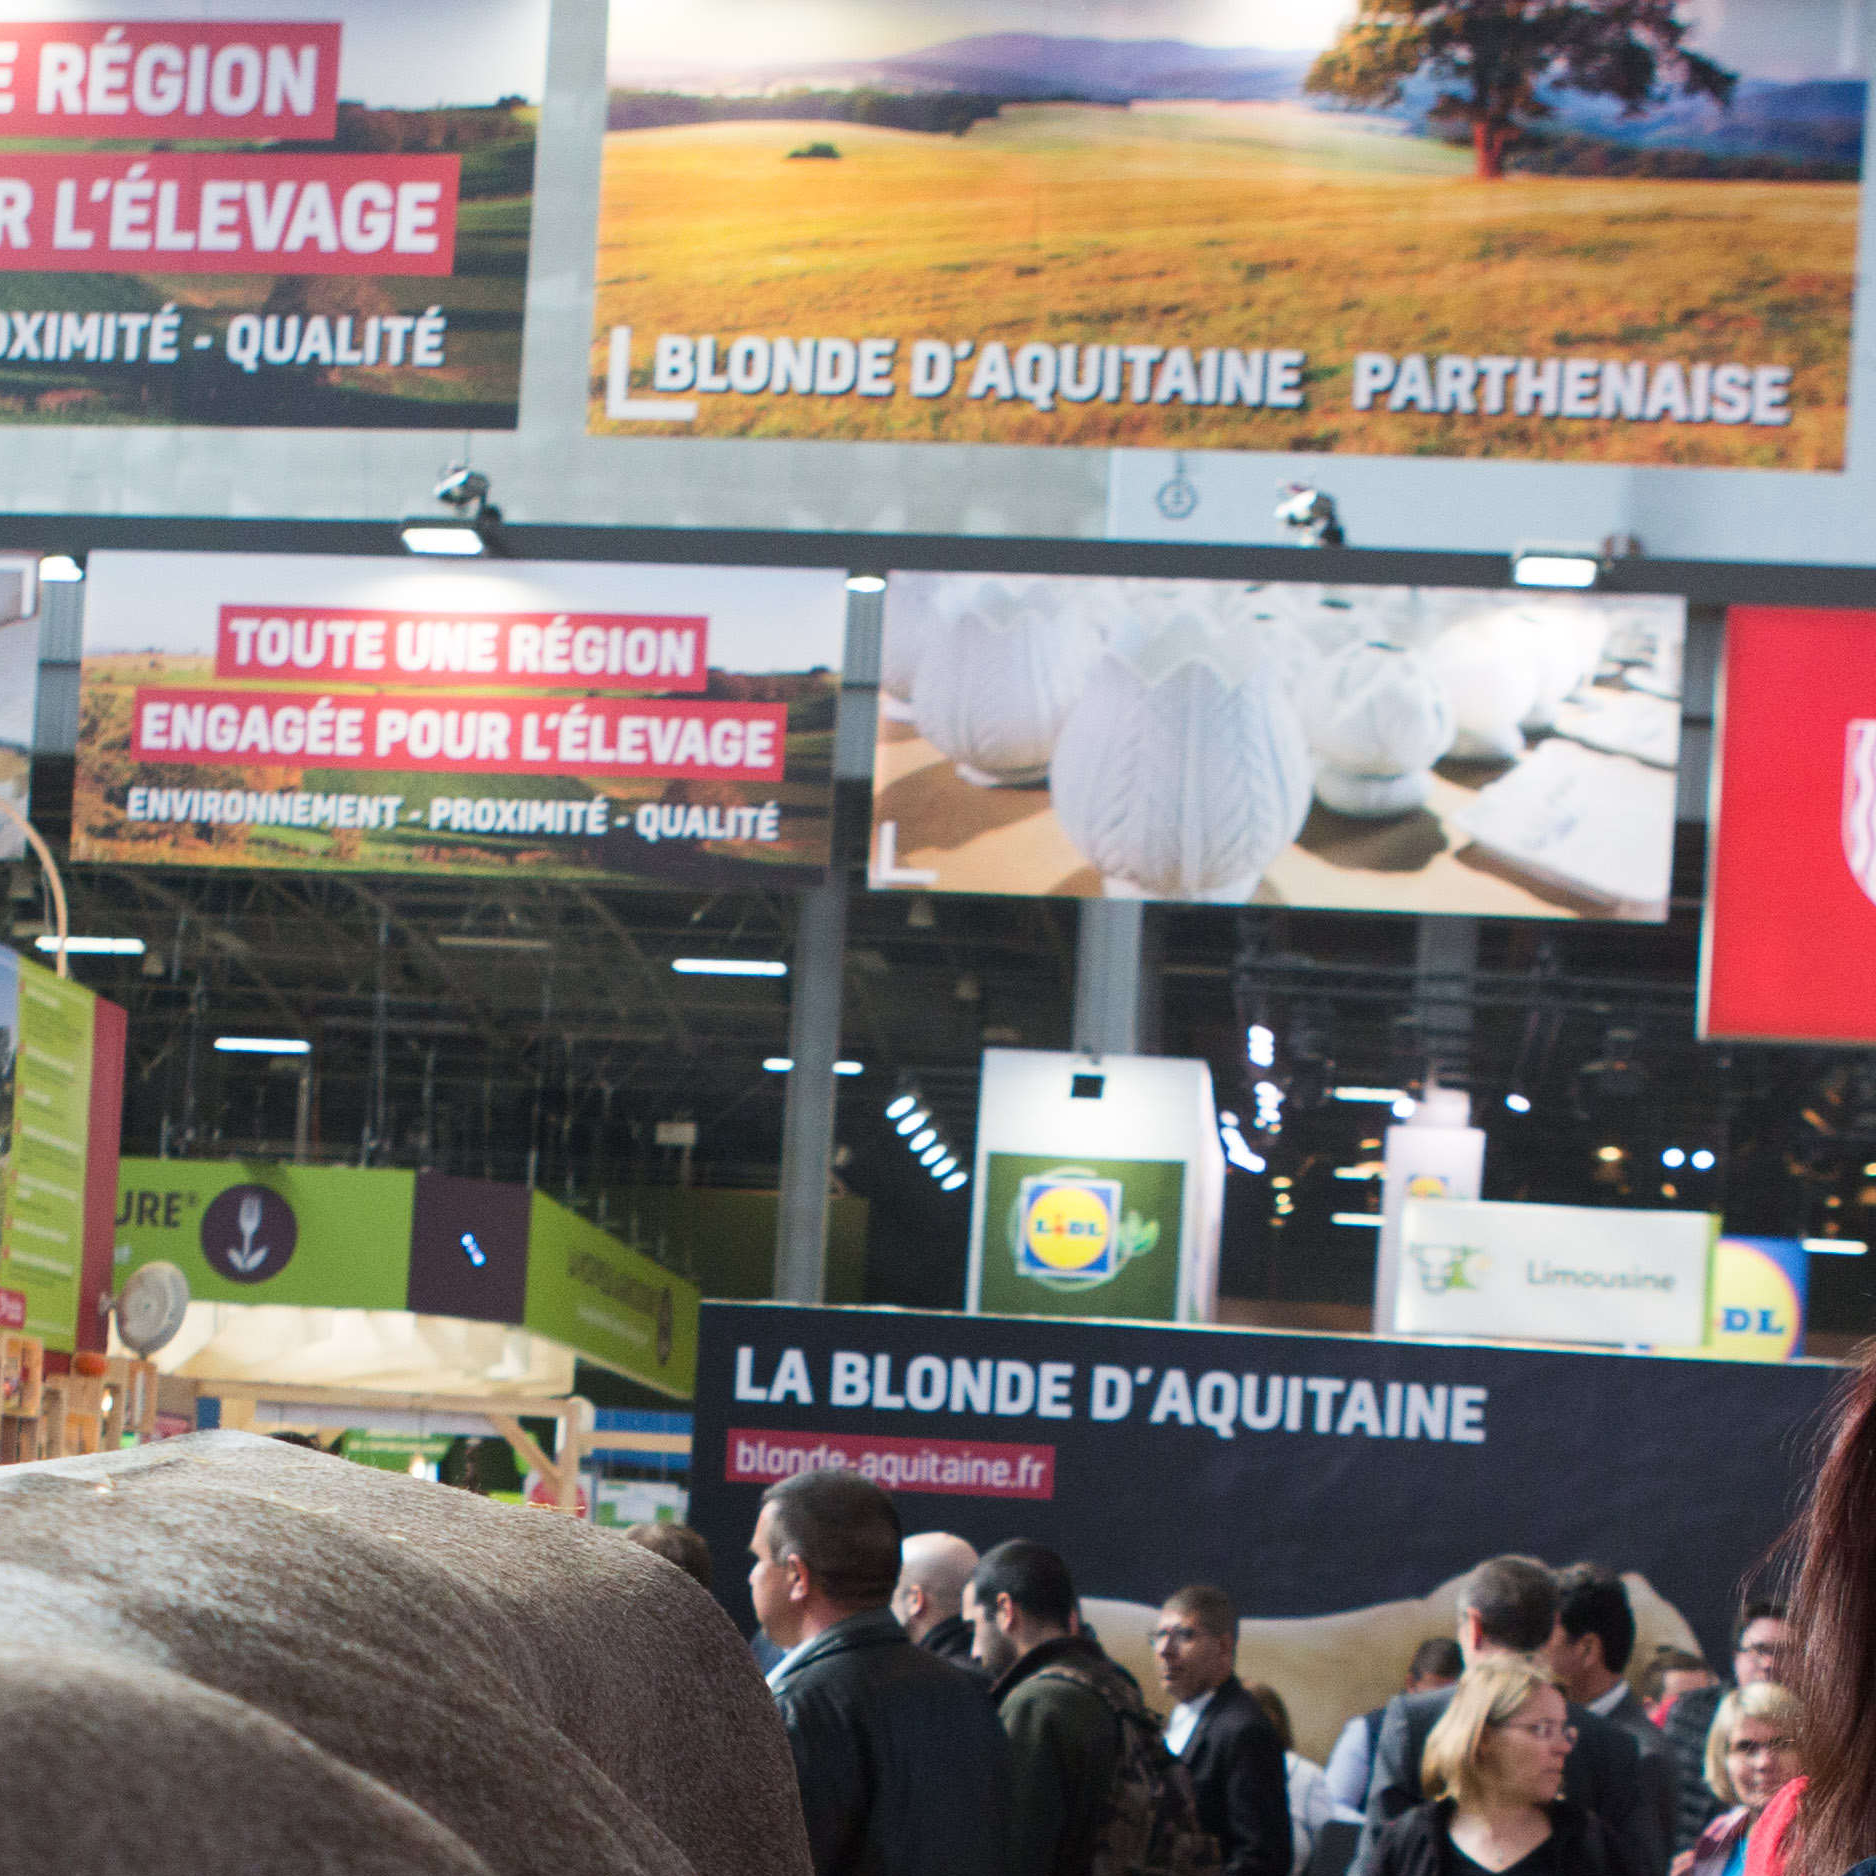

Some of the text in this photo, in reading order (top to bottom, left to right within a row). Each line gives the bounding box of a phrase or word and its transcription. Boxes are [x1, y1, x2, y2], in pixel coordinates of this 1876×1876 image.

[36, 29, 318, 117] RÉGION
[52, 162, 442, 254] L'ÉLEVAGE
[225, 305, 448, 373] QUALITÉ
[654, 335, 1306, 411] BLONDE D'AQUITAINE
[1352, 351, 1794, 426] PARTHENAISE
[228, 615, 697, 677] TOUTE UNE RÉGION
[140, 696, 776, 768] ENGAGÉE POUR L'ÉLEVAGE
[126, 786, 405, 830] ENVIRONNEMENT
[428, 795, 610, 836] PROXIMITÉ
[635, 801, 781, 843] QUALITÉ
[1527, 1258, 1677, 1293] Limousine
[734, 1346, 1489, 1443] LA BLONDE D'AQUITAINE
[735, 1439, 1046, 1490] blonde-aquitaine.fr
